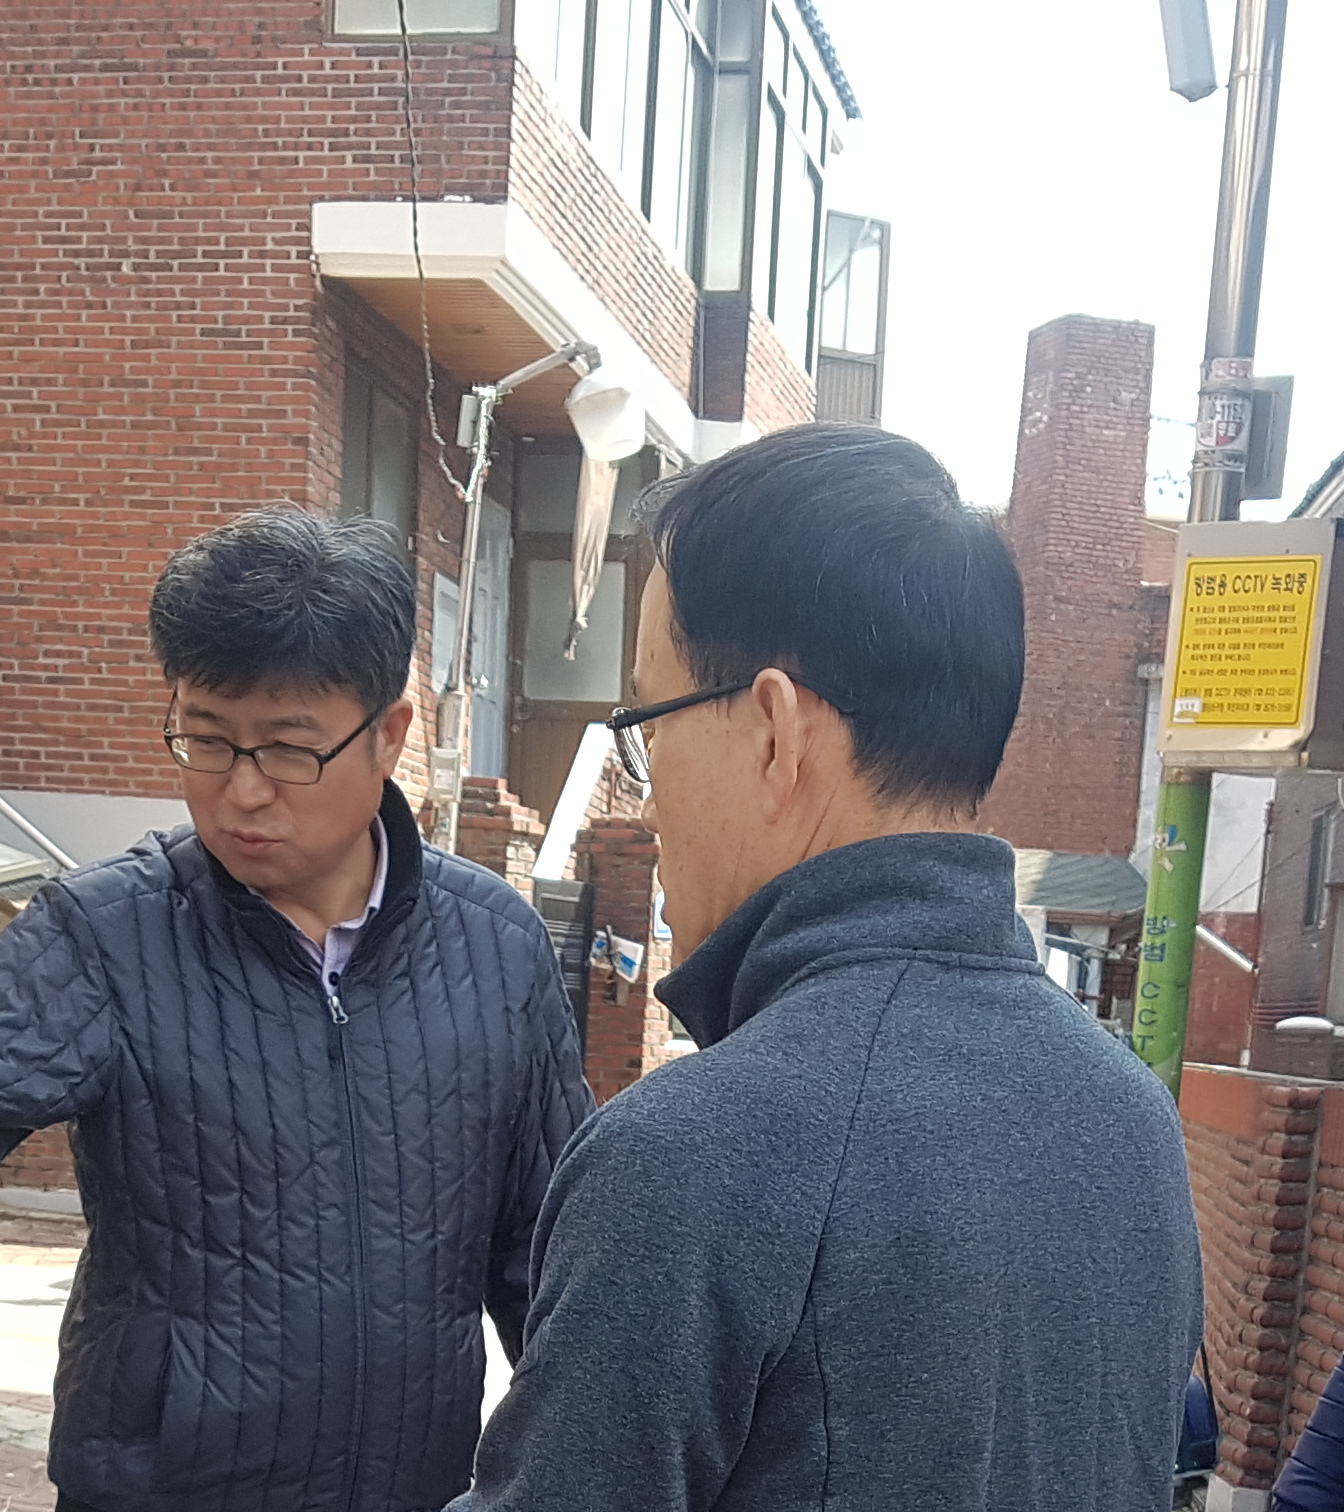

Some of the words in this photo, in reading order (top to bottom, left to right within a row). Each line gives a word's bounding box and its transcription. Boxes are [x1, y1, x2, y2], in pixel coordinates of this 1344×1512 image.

[1194, 573, 1227, 596] 방범용
[1232, 574, 1268, 594] CCTV
[1271, 572, 1308, 595] 녹화중
